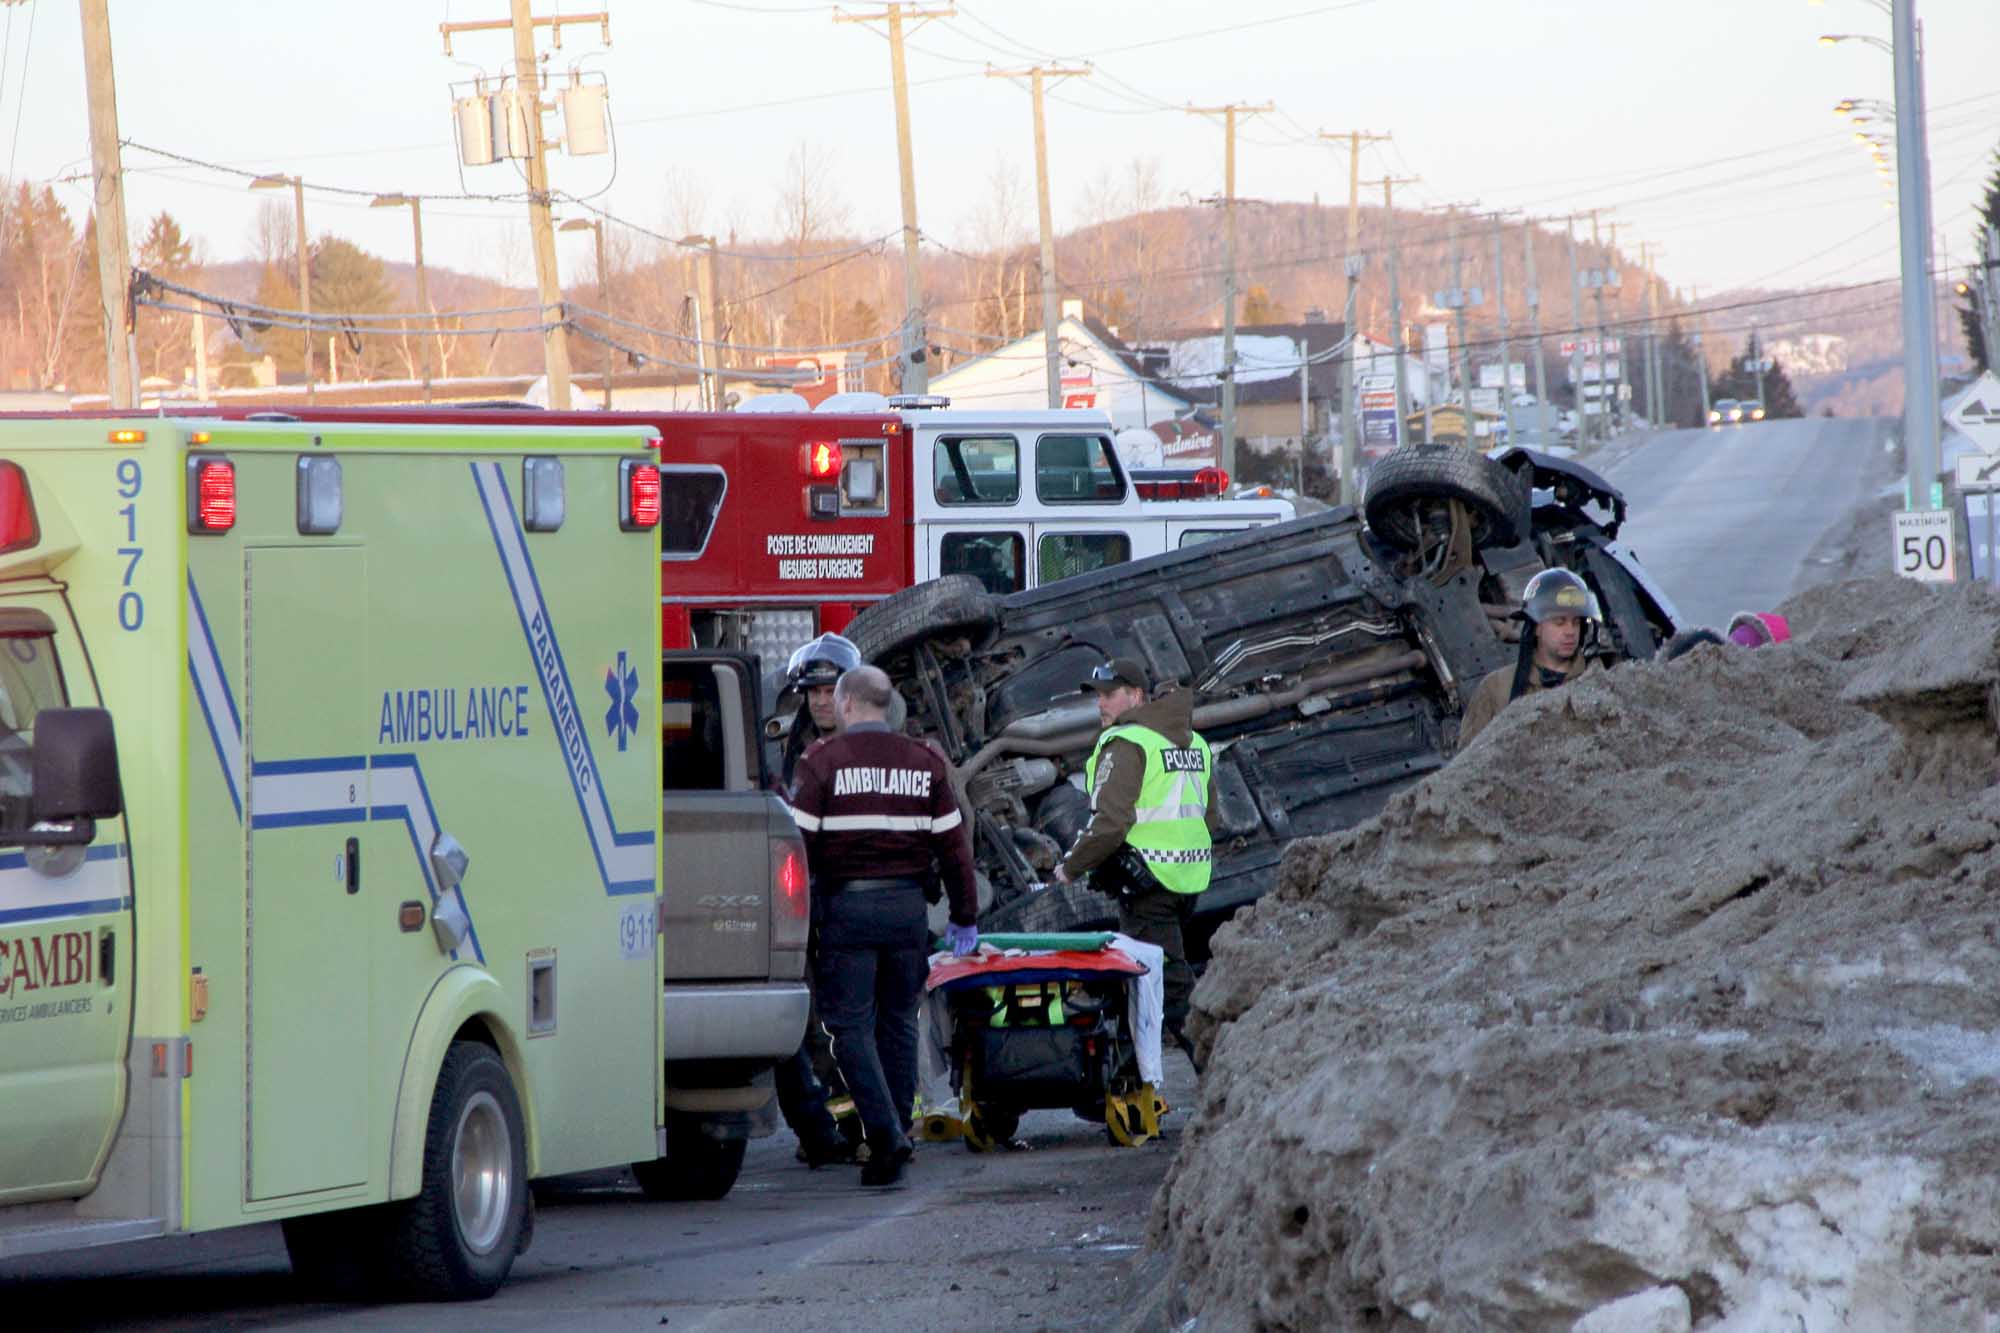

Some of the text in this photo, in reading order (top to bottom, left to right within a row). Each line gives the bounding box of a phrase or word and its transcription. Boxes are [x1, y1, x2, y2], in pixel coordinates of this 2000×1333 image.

[1899, 517, 1948, 528] MAXIMUM
[116, 459, 144, 632] 9170
[767, 534, 874, 555] POSTE DE COMMANDEMENT
[1903, 535, 1946, 571] 50
[780, 559, 863, 579] MESURES D'URGENCE
[379, 686, 529, 744] AMBULANCE
[531, 610, 591, 793] PARAMEDIC
[1164, 750, 1203, 770] POLICE
[834, 767, 932, 797] AMBULANCE
